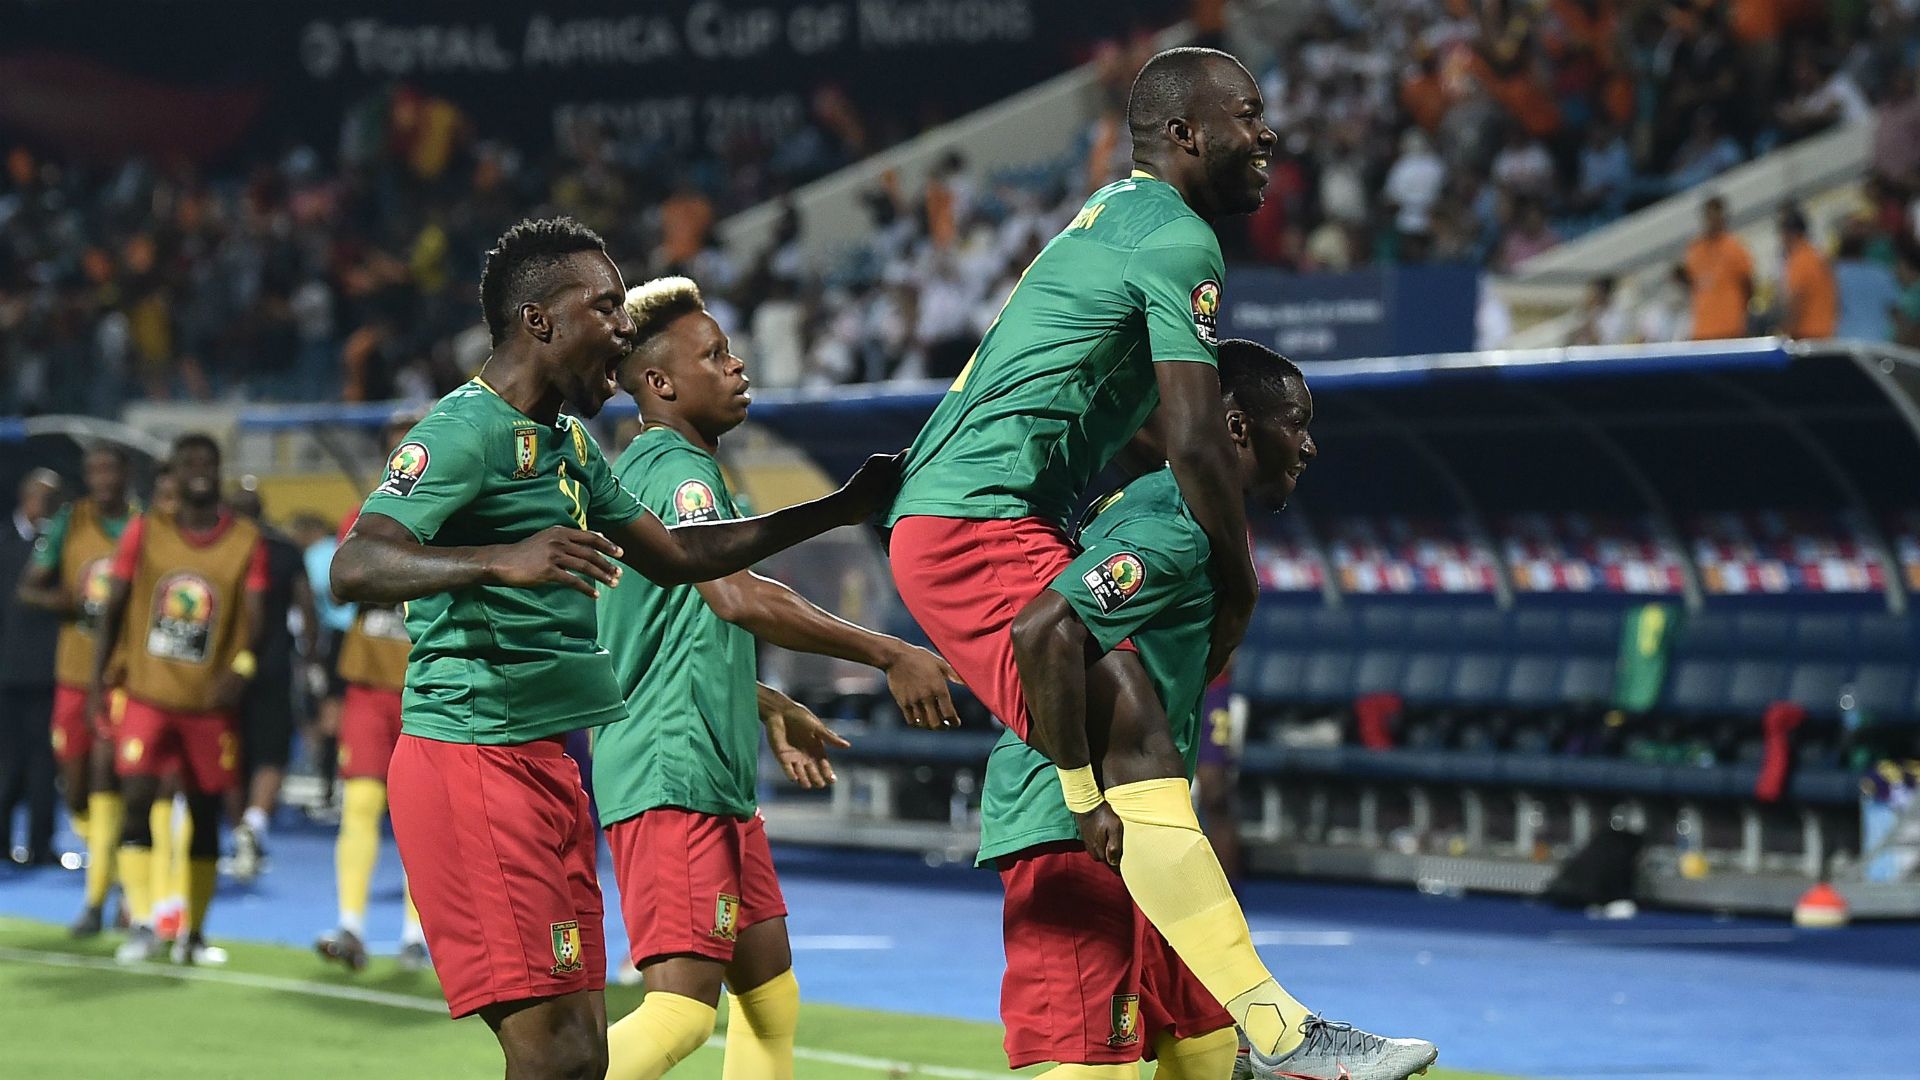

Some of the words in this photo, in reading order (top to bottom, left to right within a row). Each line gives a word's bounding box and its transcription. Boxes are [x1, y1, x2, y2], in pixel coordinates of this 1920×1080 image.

[522, 14, 679, 66] AFRICA
[685, 1, 781, 58] CUP
[786, 9, 842, 54] OF
